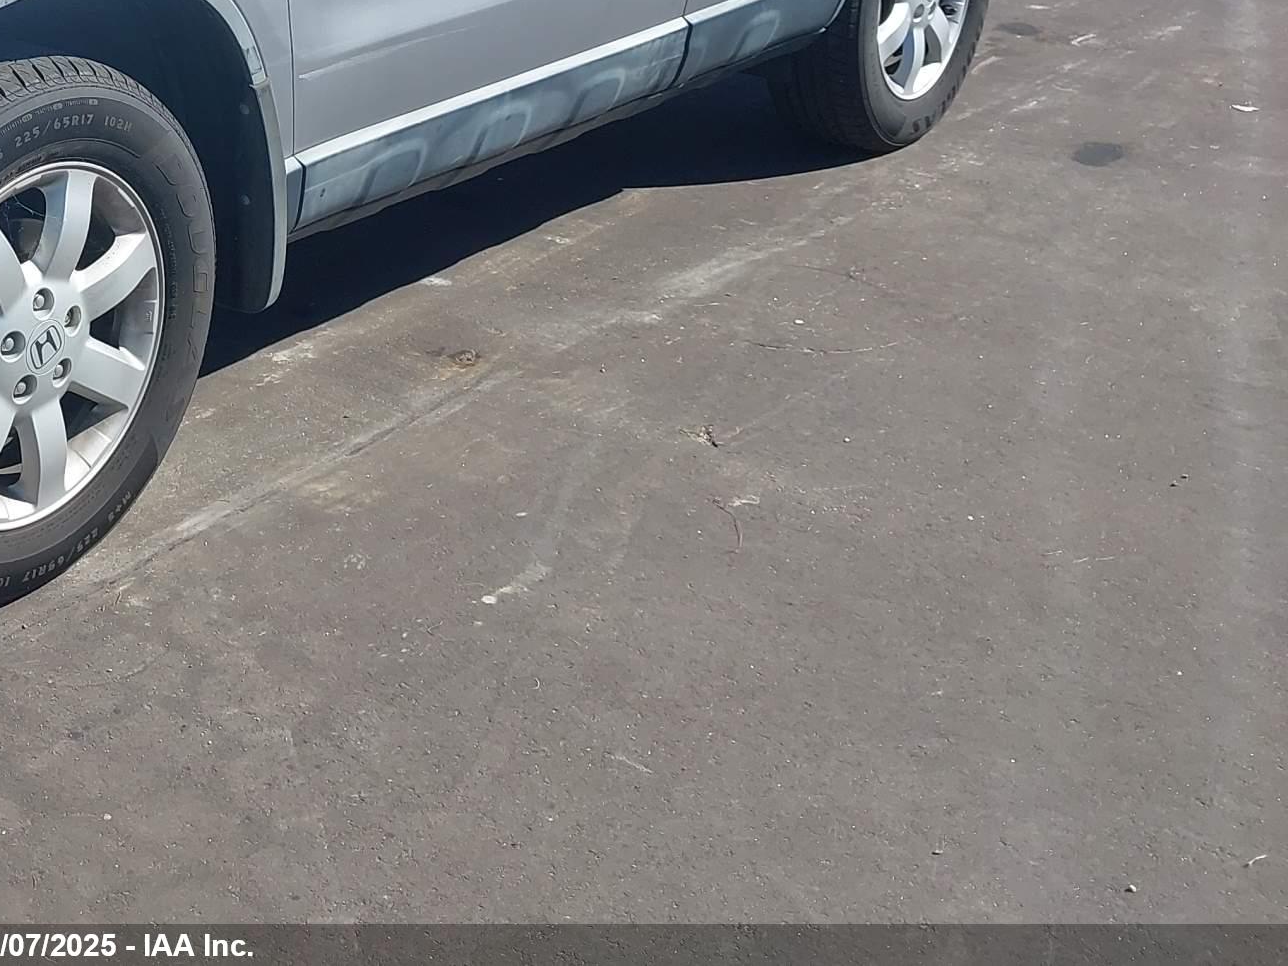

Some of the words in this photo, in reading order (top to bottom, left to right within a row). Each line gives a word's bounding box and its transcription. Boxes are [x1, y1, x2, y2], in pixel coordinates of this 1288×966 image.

[14, 112, 95, 149] 225/65R17
[103, 114, 134, 133] 102H
[21, 526, 101, 584] 225/65R17
